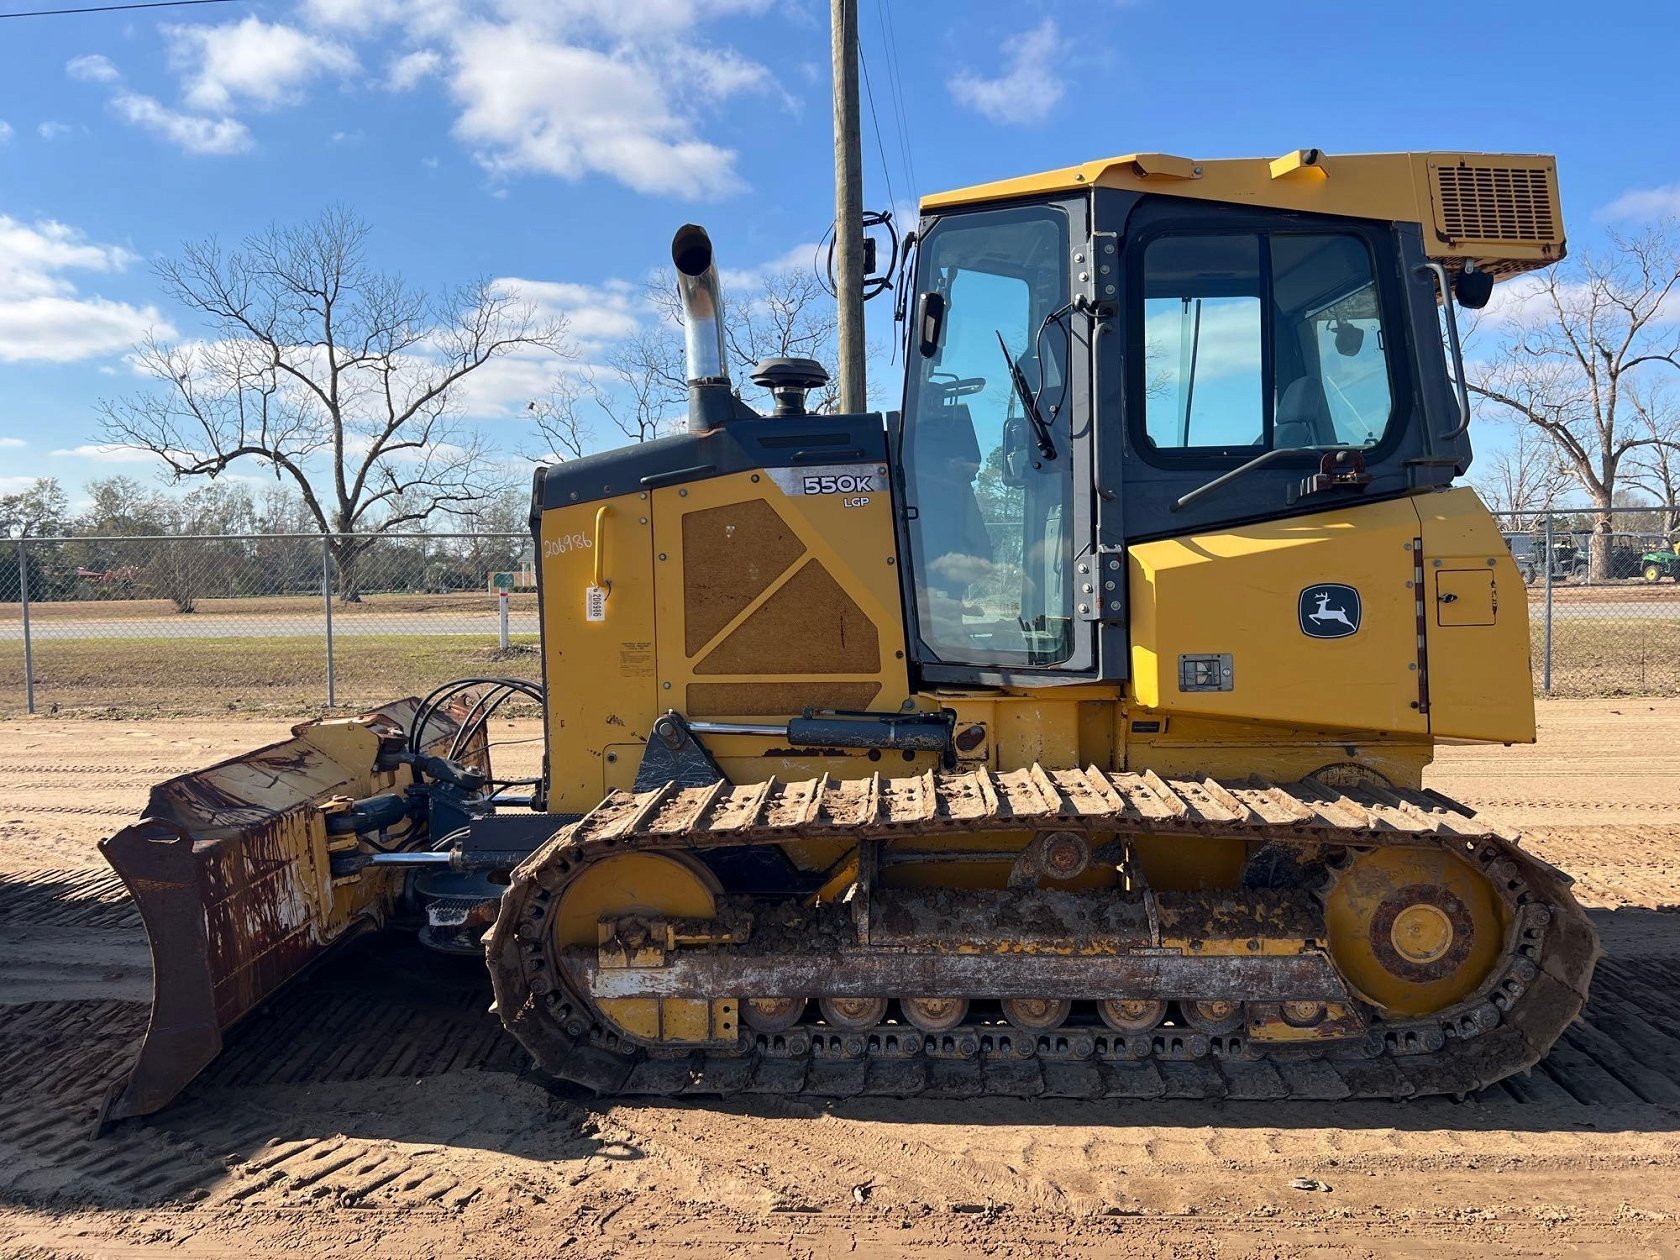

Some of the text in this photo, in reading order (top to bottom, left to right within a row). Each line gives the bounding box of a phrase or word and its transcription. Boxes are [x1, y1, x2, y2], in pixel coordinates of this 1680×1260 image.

[803, 475, 874, 495] 550K
[844, 497, 870, 508] LGP
[544, 531, 593, 558] 206986
